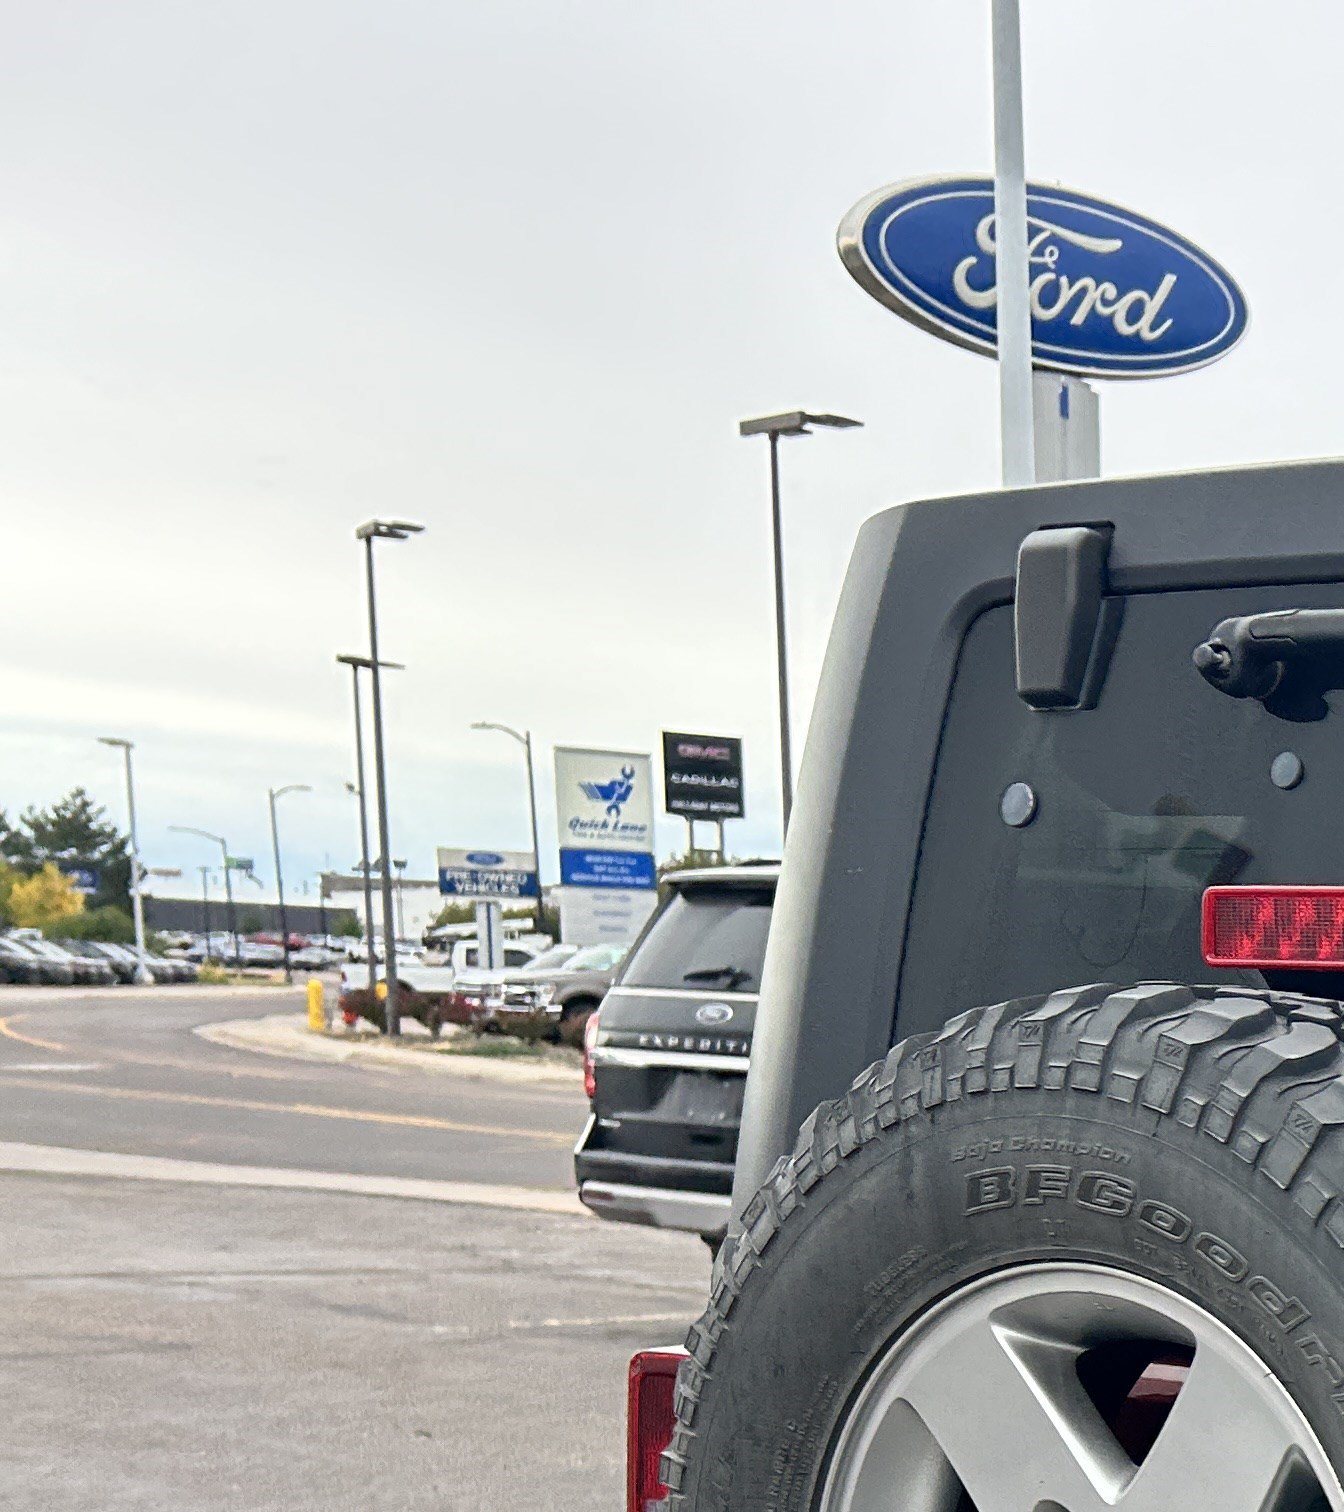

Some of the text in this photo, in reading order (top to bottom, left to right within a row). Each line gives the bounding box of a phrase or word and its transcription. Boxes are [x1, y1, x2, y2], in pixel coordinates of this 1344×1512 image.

[952, 212, 1178, 341] Ford
[670, 772, 740, 789] CADILLAC
[568, 816, 648, 832] Quick Lane
[455, 881, 520, 894] VEHICLES
[638, 1034, 748, 1055] EXPEDITI
[1010, 1136, 1132, 1164] Champion
